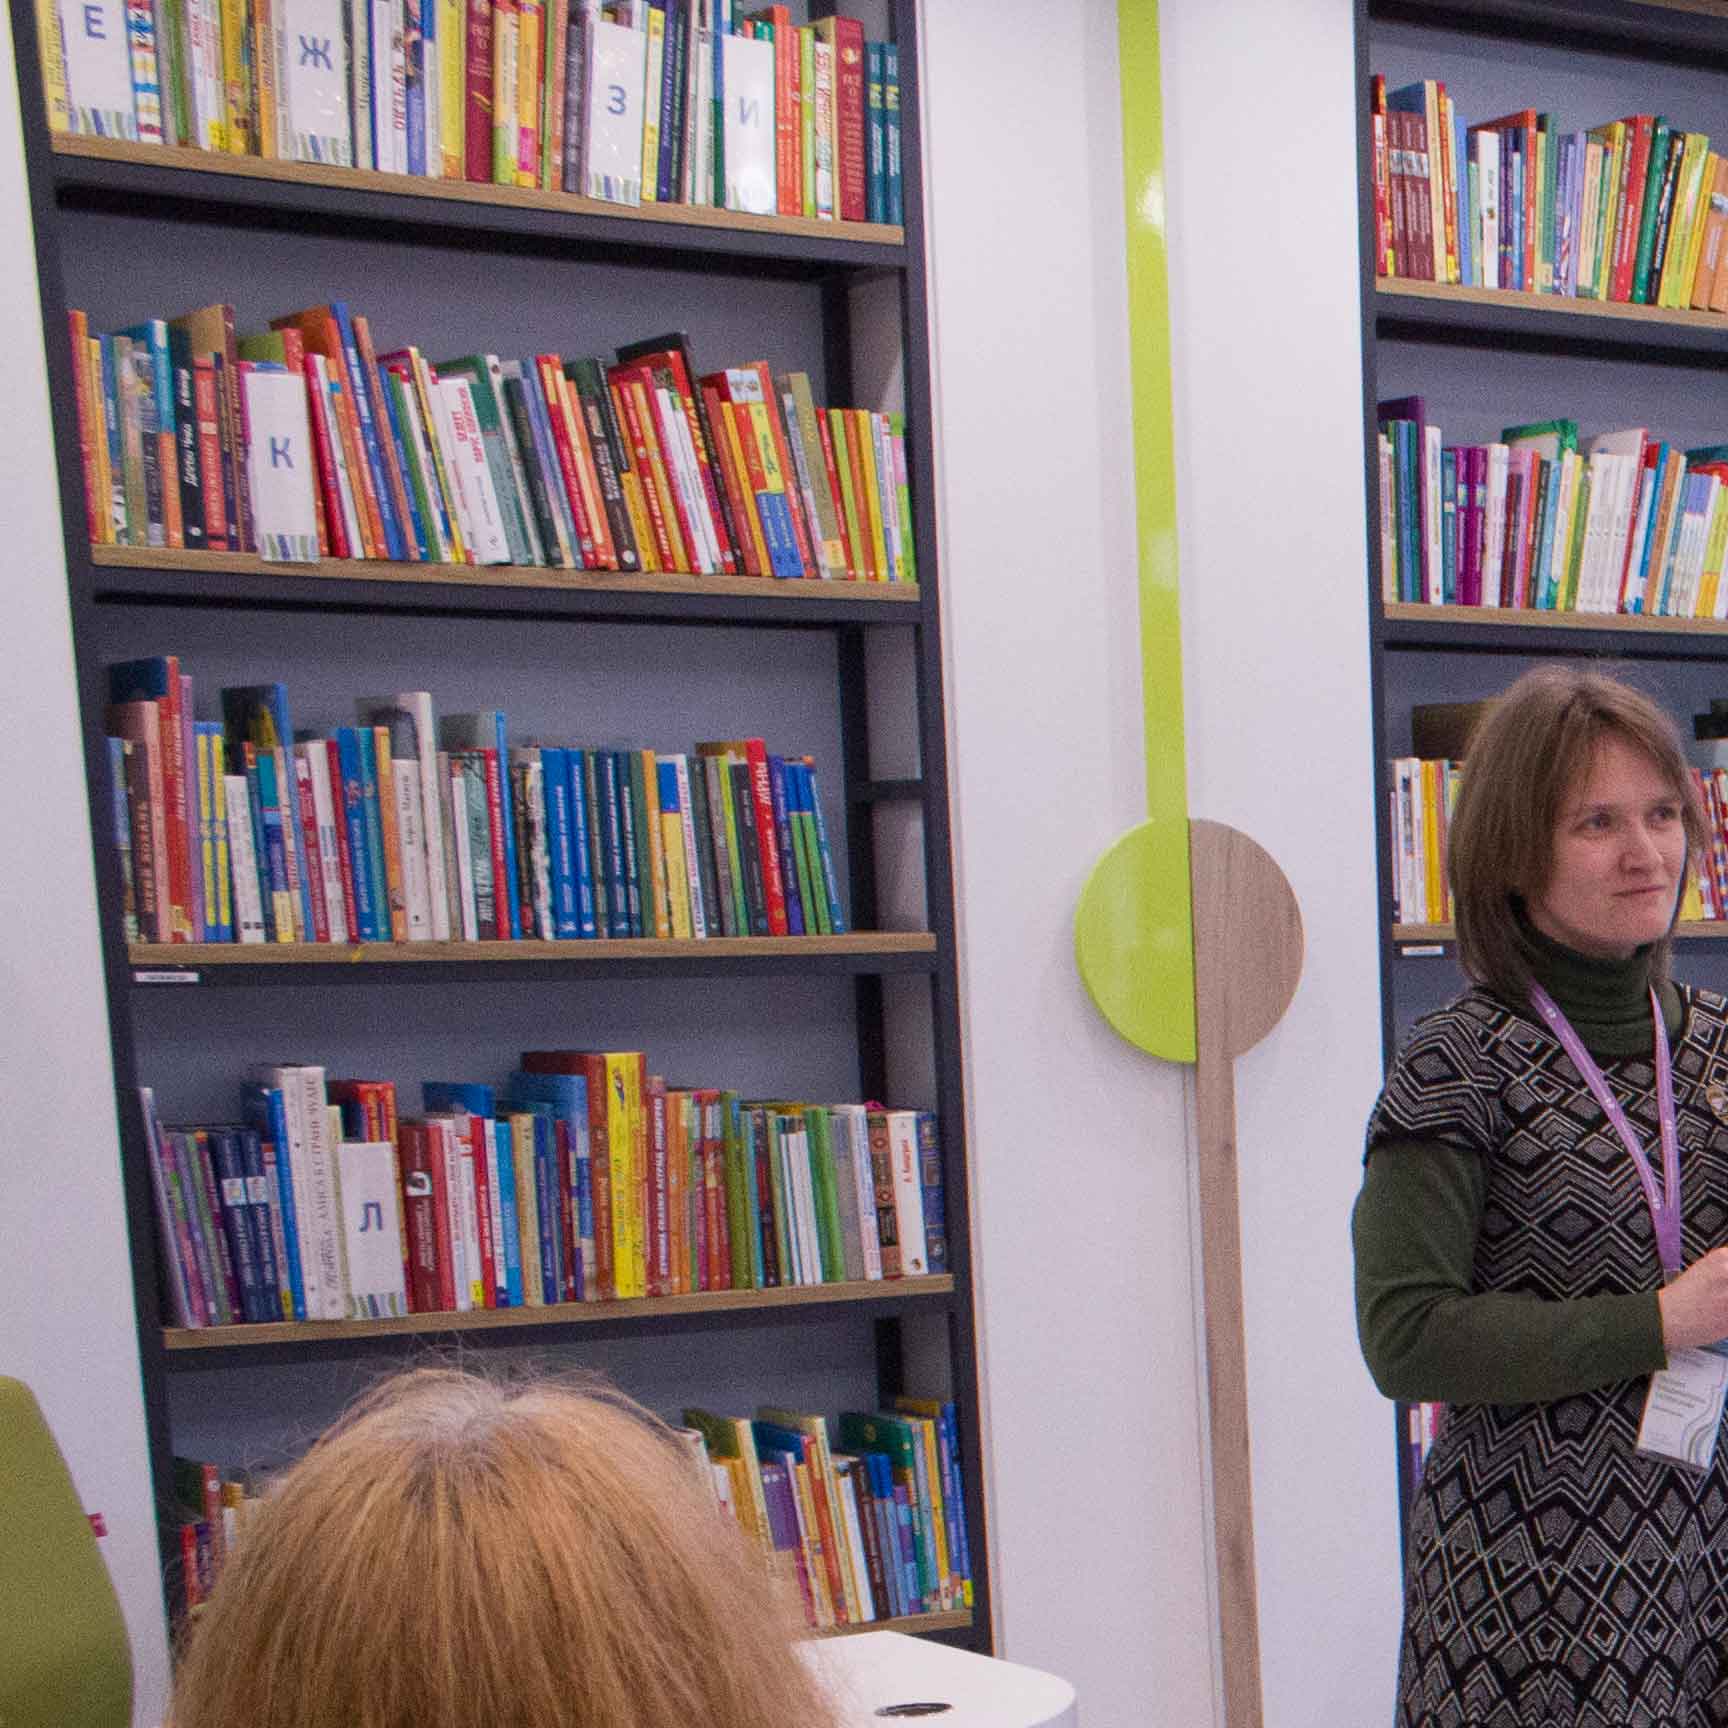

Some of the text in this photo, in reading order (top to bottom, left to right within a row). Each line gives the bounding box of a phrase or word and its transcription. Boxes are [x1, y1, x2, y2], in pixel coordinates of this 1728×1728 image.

[84, 5, 106, 40] Е
[298, 35, 333, 70] Ж
[607, 85, 626, 116] З
[270, 436, 296, 469] К
[359, 1201, 384, 1233] Л
